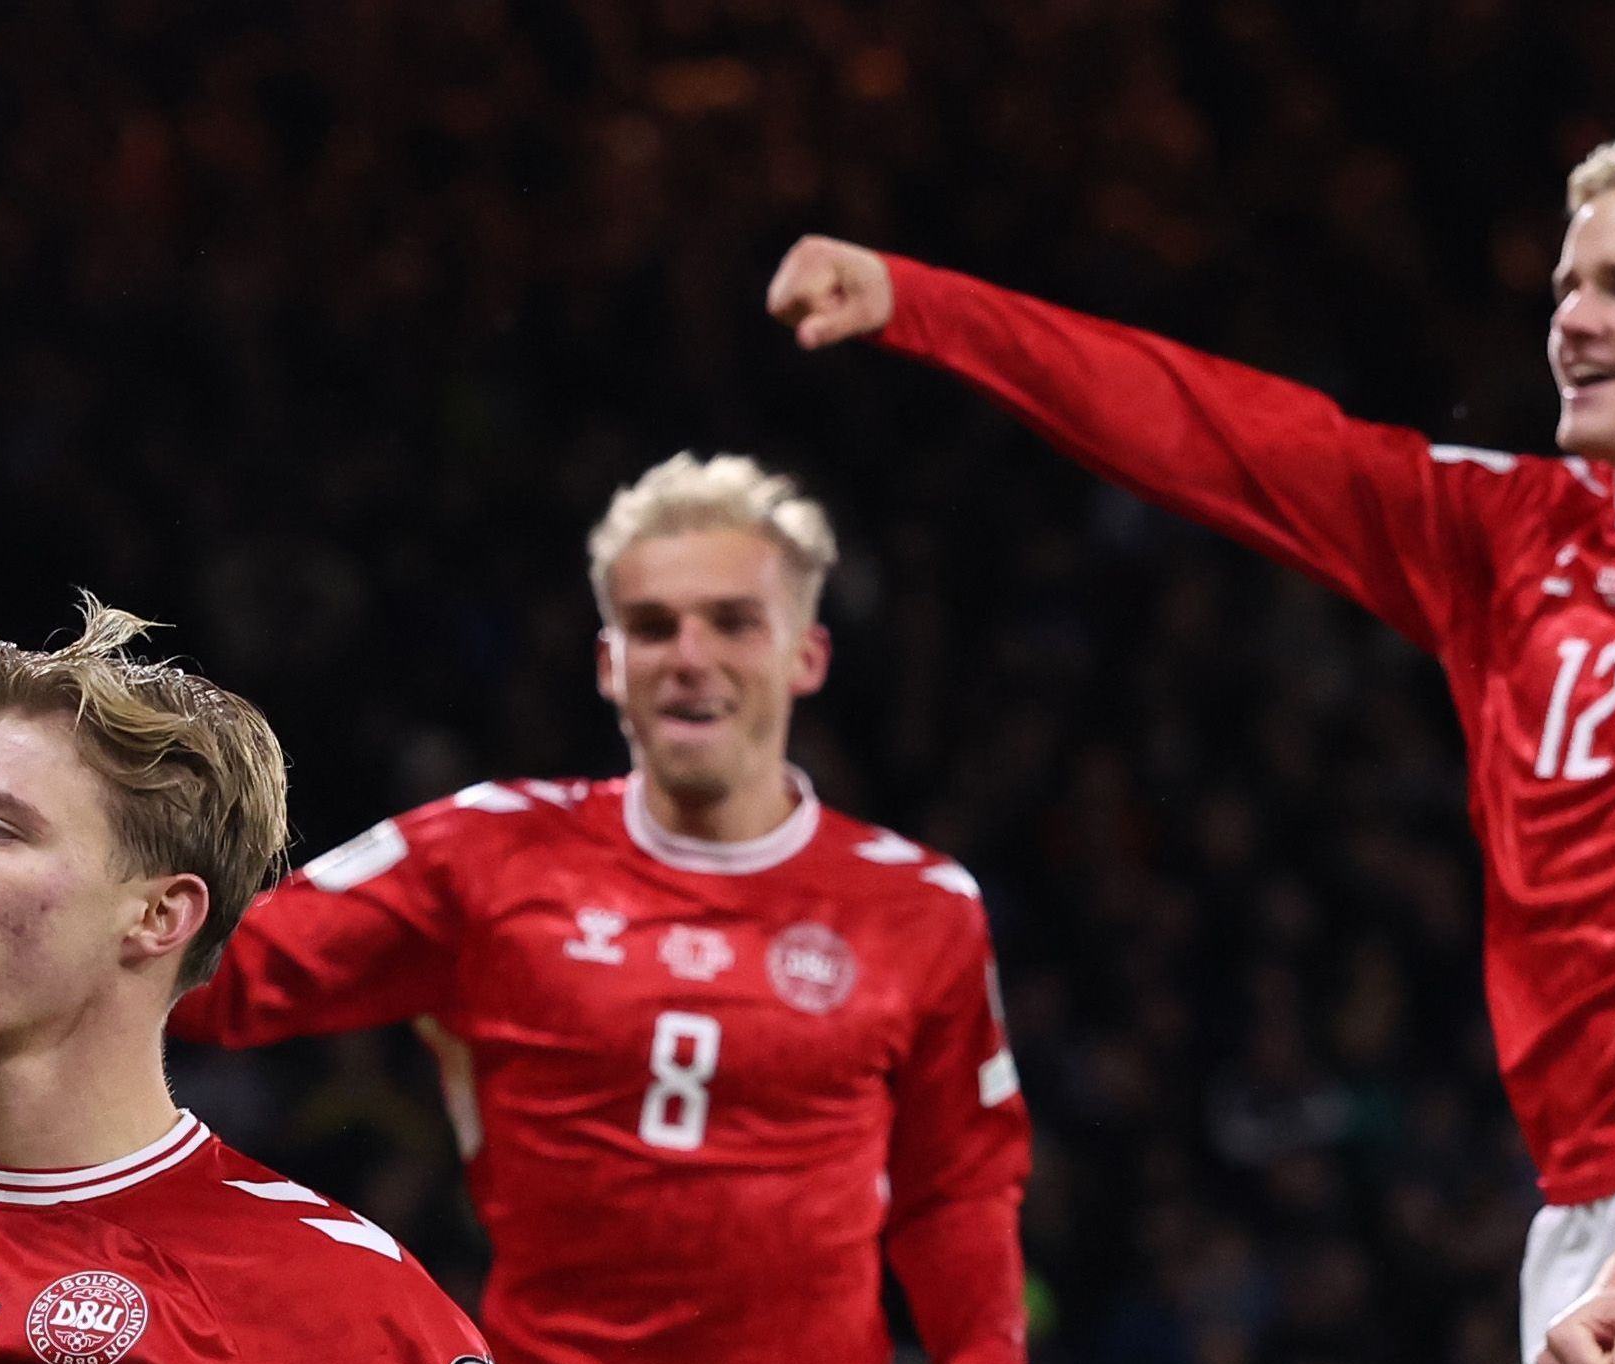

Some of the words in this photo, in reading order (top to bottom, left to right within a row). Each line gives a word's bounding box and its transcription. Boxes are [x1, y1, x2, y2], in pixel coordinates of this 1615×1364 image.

[638, 1010, 721, 1151] 8
[31, 1291, 59, 1352] DANSK
[49, 1300, 125, 1334] DBU
